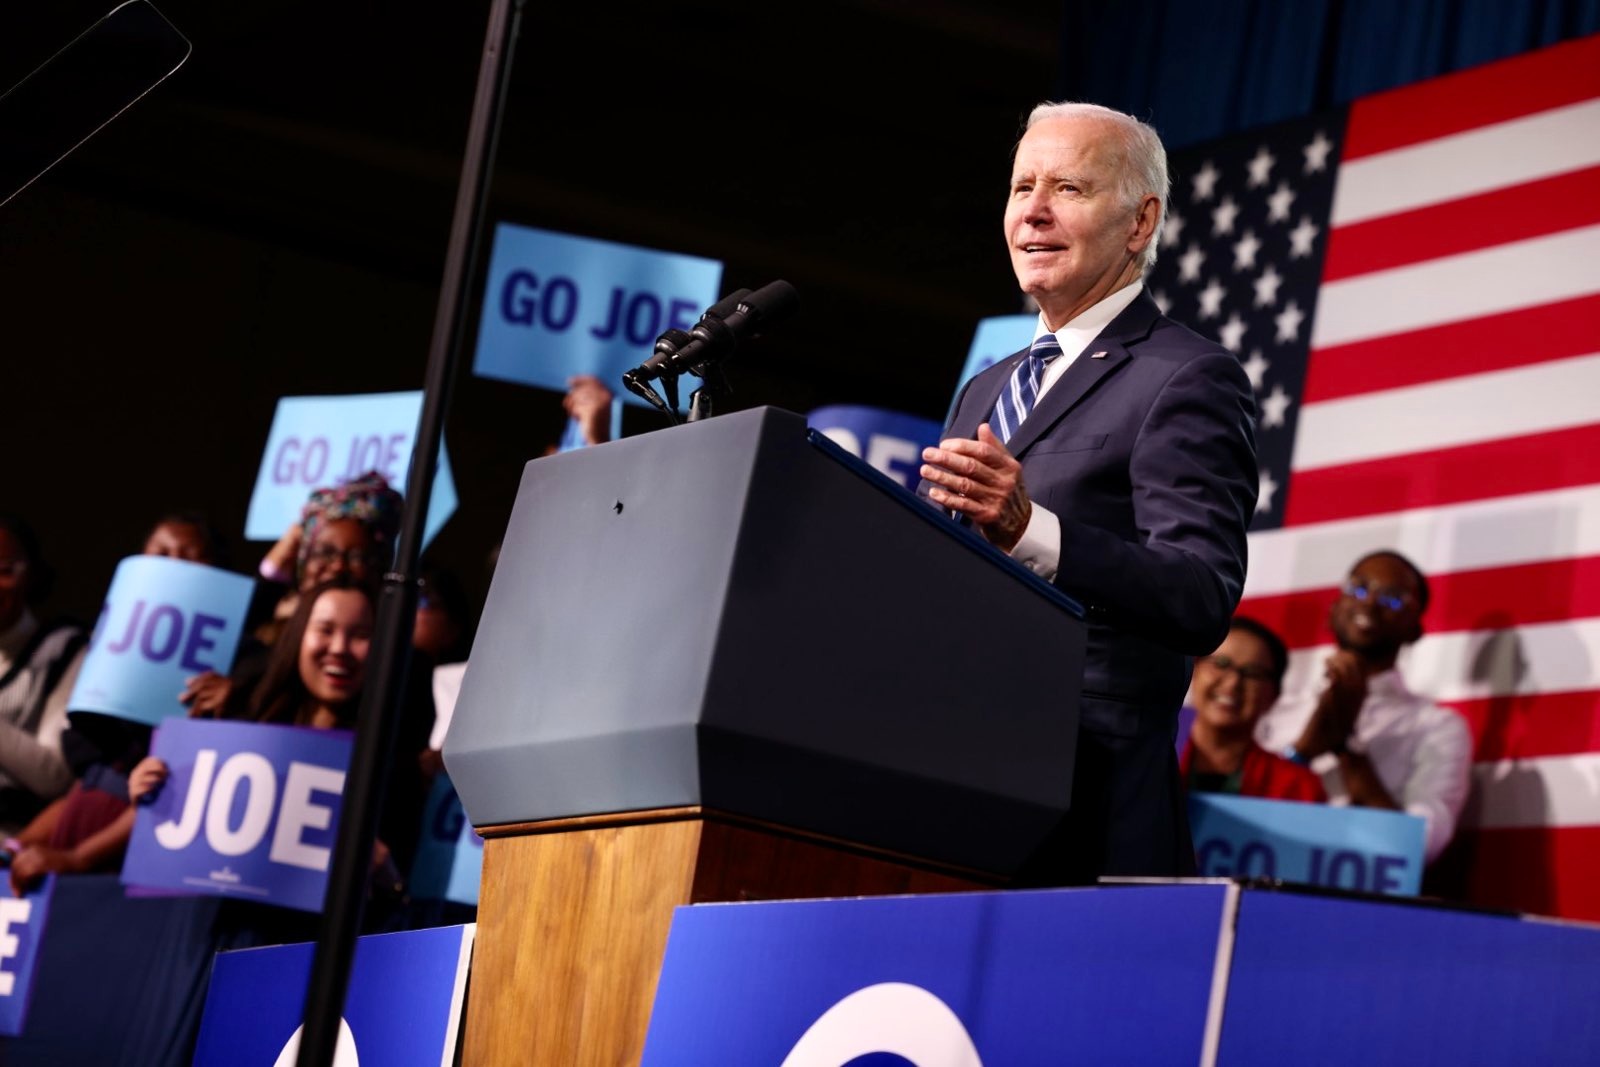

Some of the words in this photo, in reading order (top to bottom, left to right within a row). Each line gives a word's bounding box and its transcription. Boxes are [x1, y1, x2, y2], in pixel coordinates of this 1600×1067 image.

[500, 266, 580, 334] GO
[271, 434, 331, 487] GO
[106, 598, 228, 674] JOE
[153, 748, 348, 873] JOE
